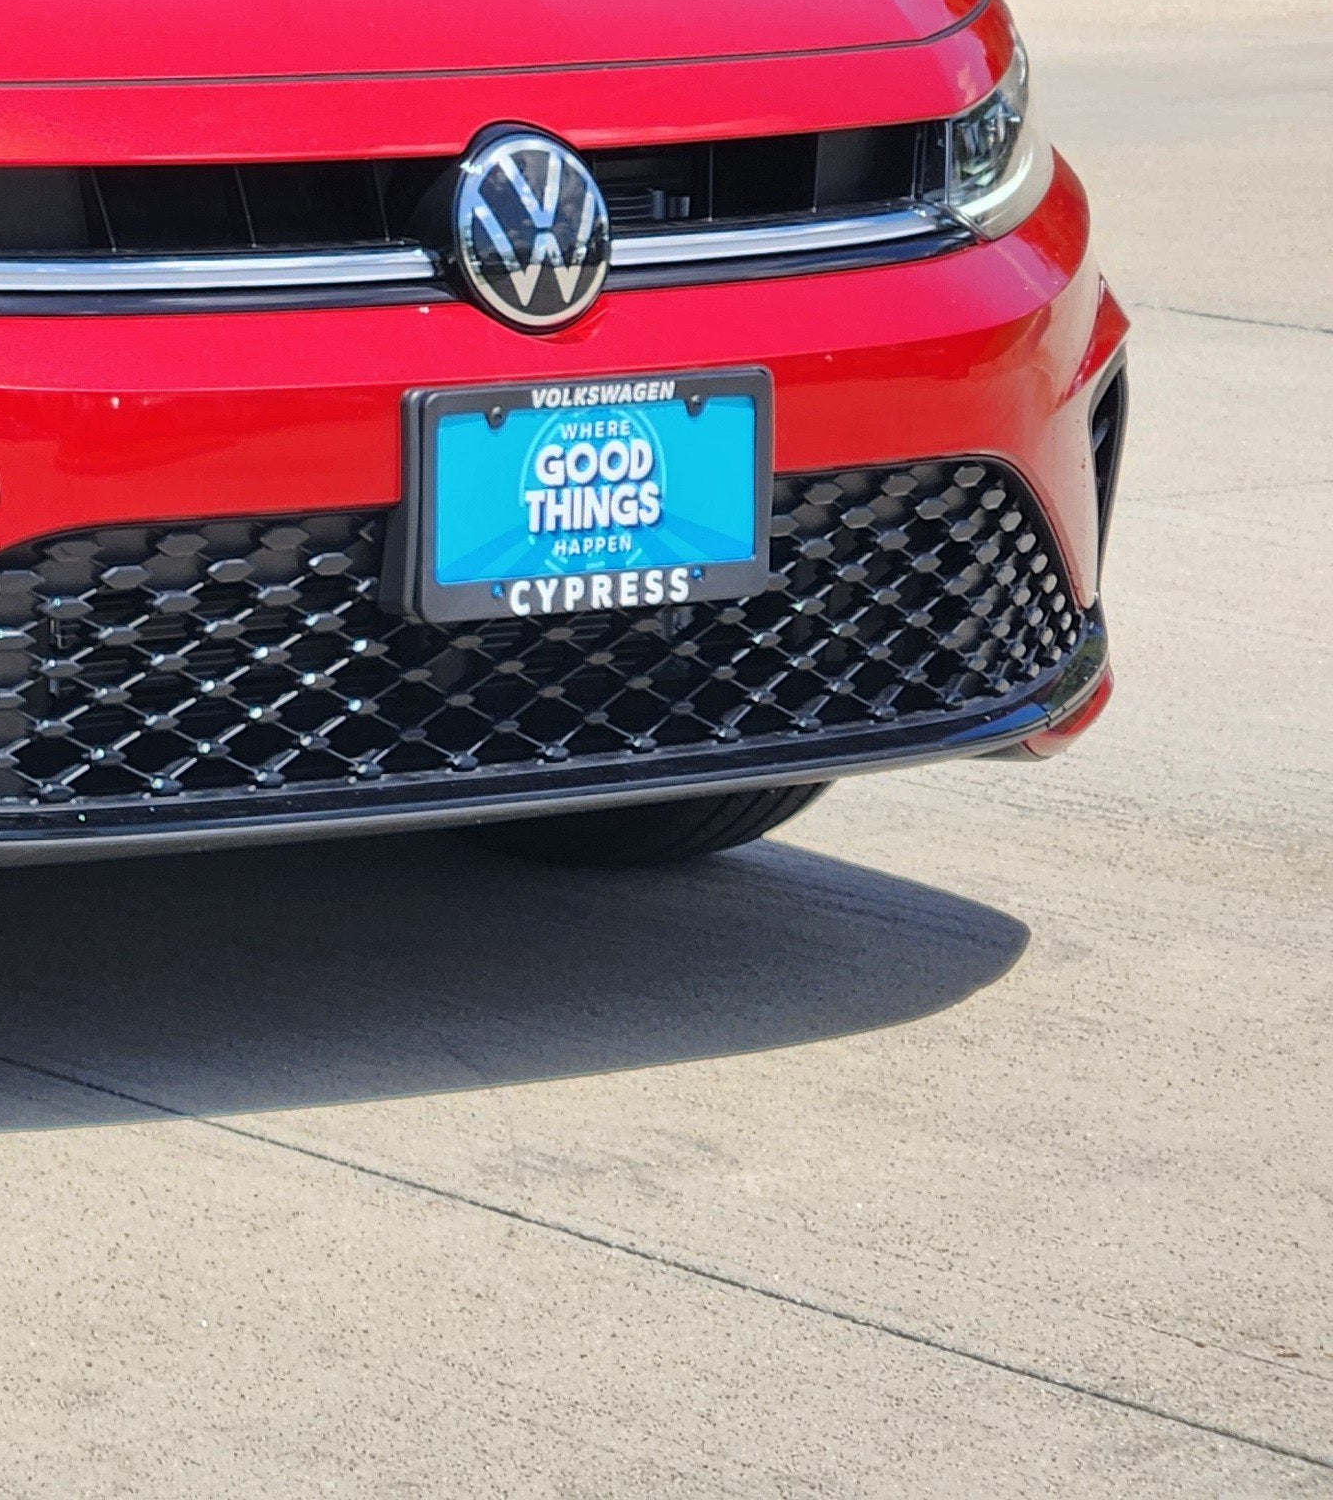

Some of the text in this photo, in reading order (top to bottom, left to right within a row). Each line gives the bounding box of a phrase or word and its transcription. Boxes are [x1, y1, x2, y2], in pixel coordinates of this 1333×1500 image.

[531, 381, 676, 409] VOLKSWAGEN
[561, 420, 631, 439] WHERE
[535, 439, 654, 486] GOOD
[525, 483, 661, 533] THINGS
[553, 536, 632, 557] HAPPEN
[509, 568, 689, 616] CYPRESS
